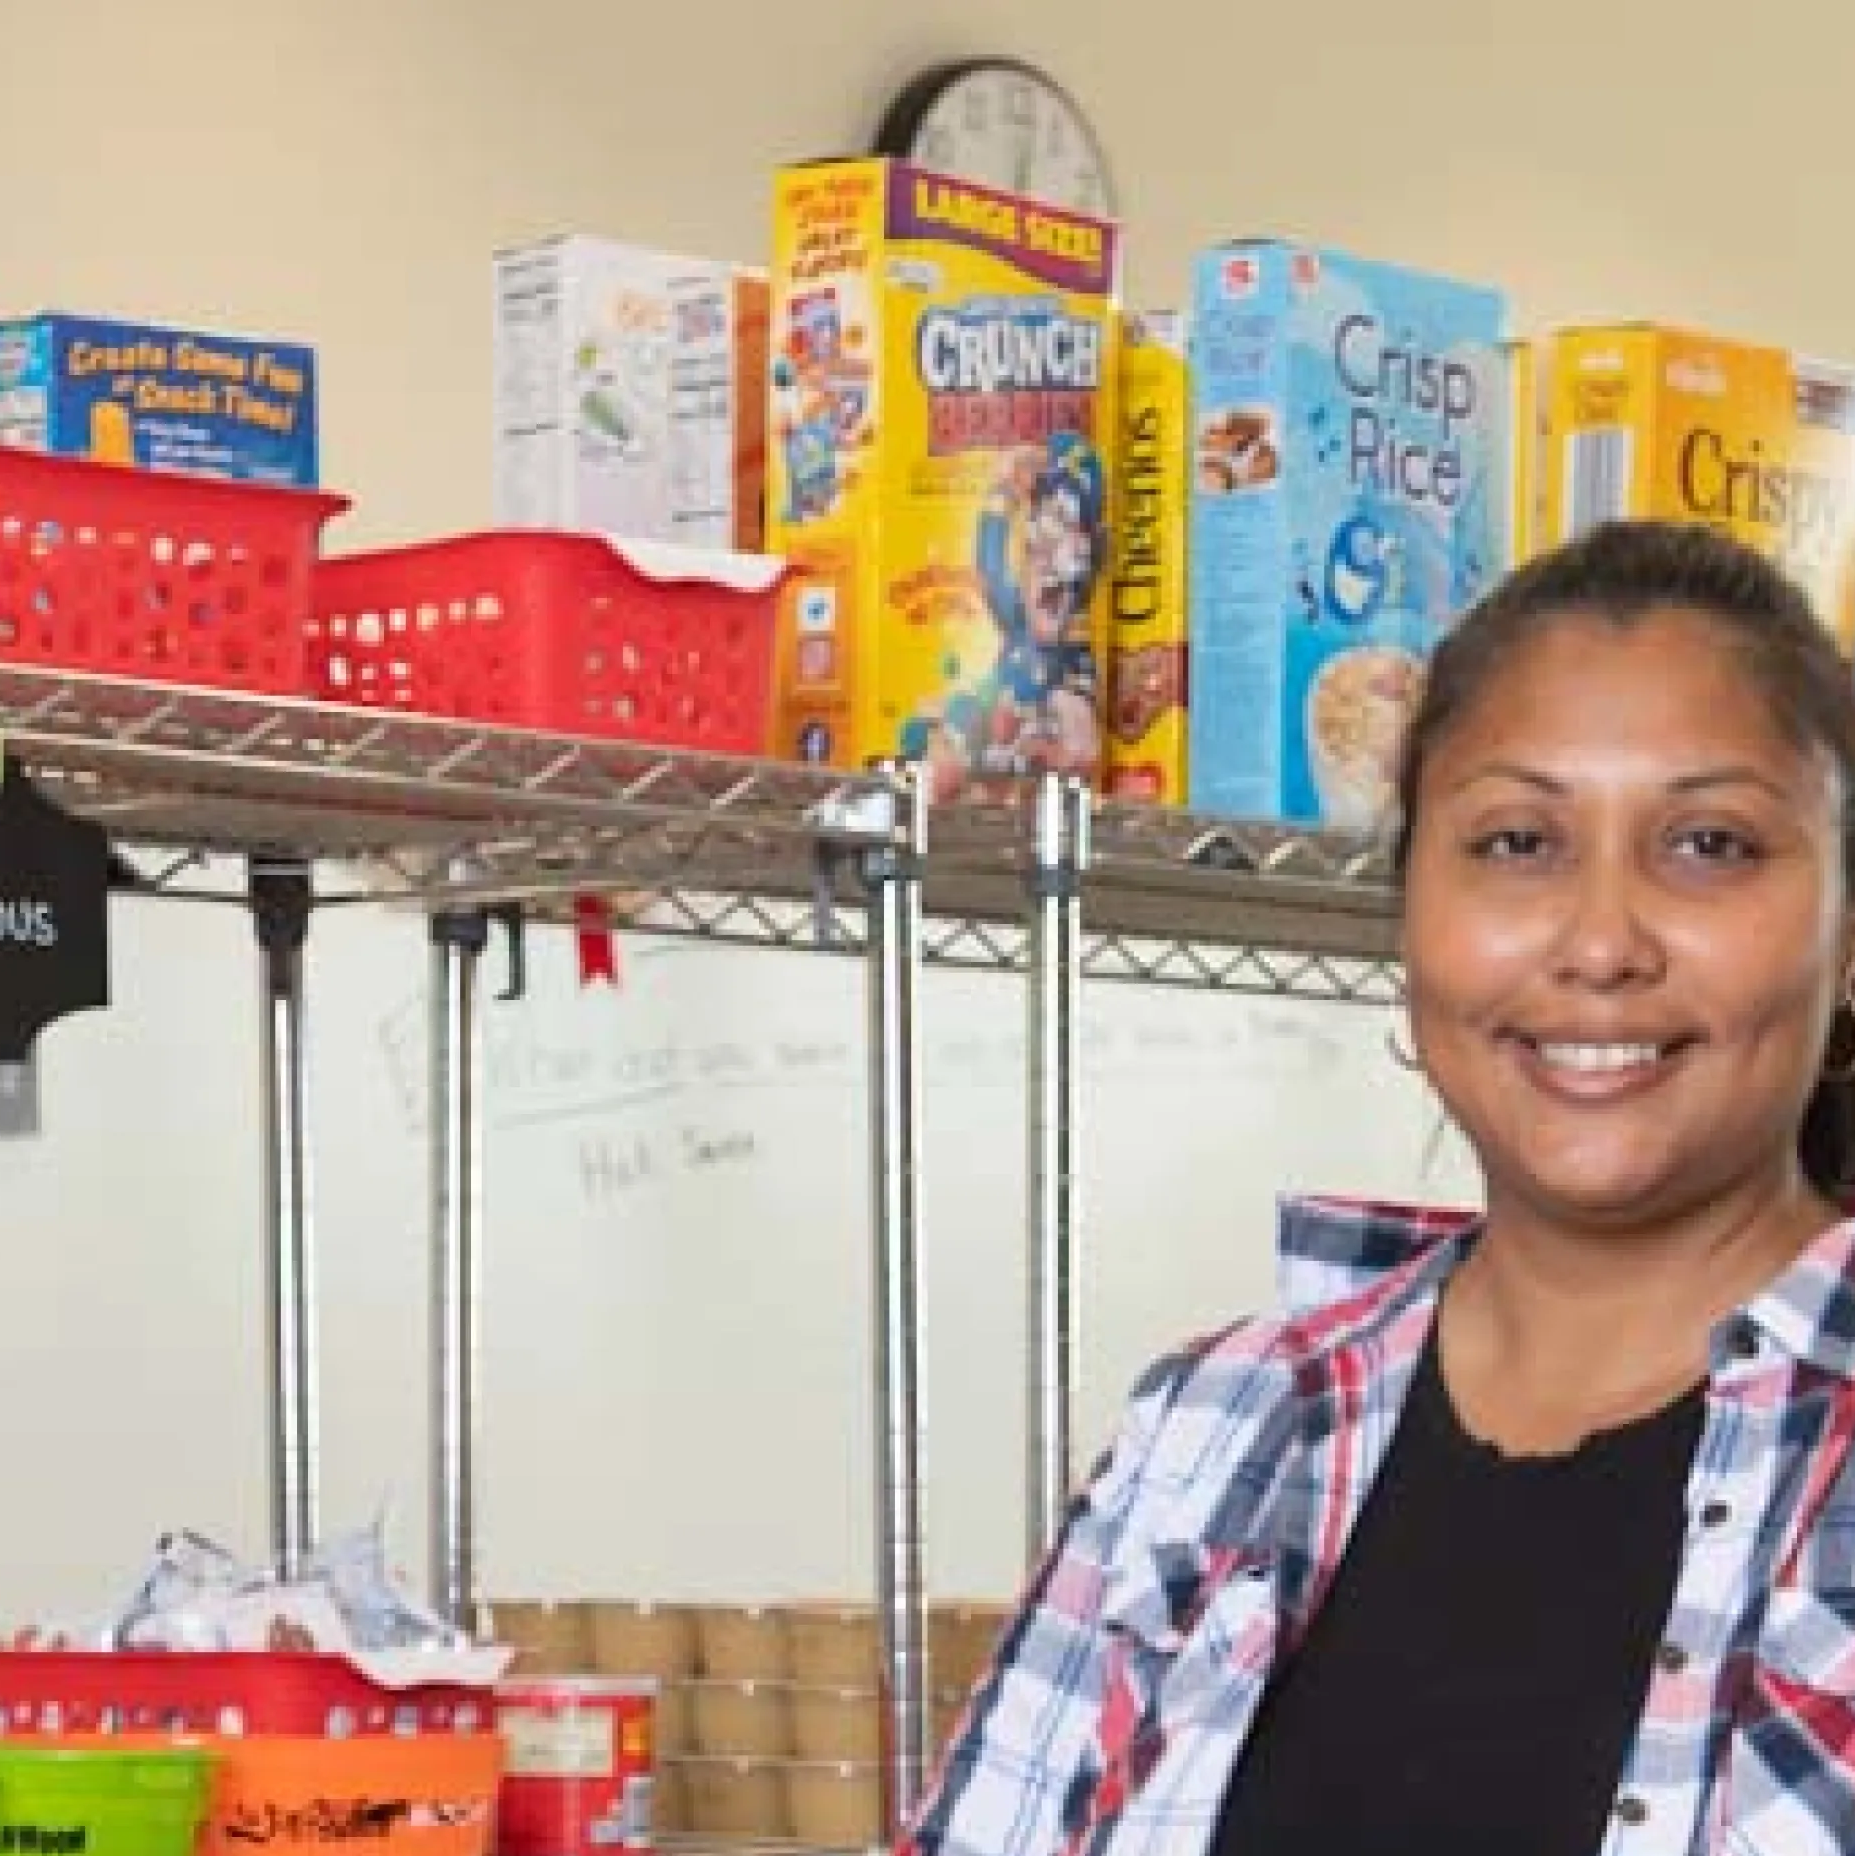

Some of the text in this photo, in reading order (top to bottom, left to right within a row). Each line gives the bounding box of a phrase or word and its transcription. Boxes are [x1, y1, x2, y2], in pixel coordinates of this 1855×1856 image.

[67, 340, 168, 375] Create
[919, 316, 1097, 390] CRUNCH
[1333, 313, 1474, 440] Crisp
[1350, 408, 1462, 505] Rice
[1111, 406, 1161, 623] Cheerios
